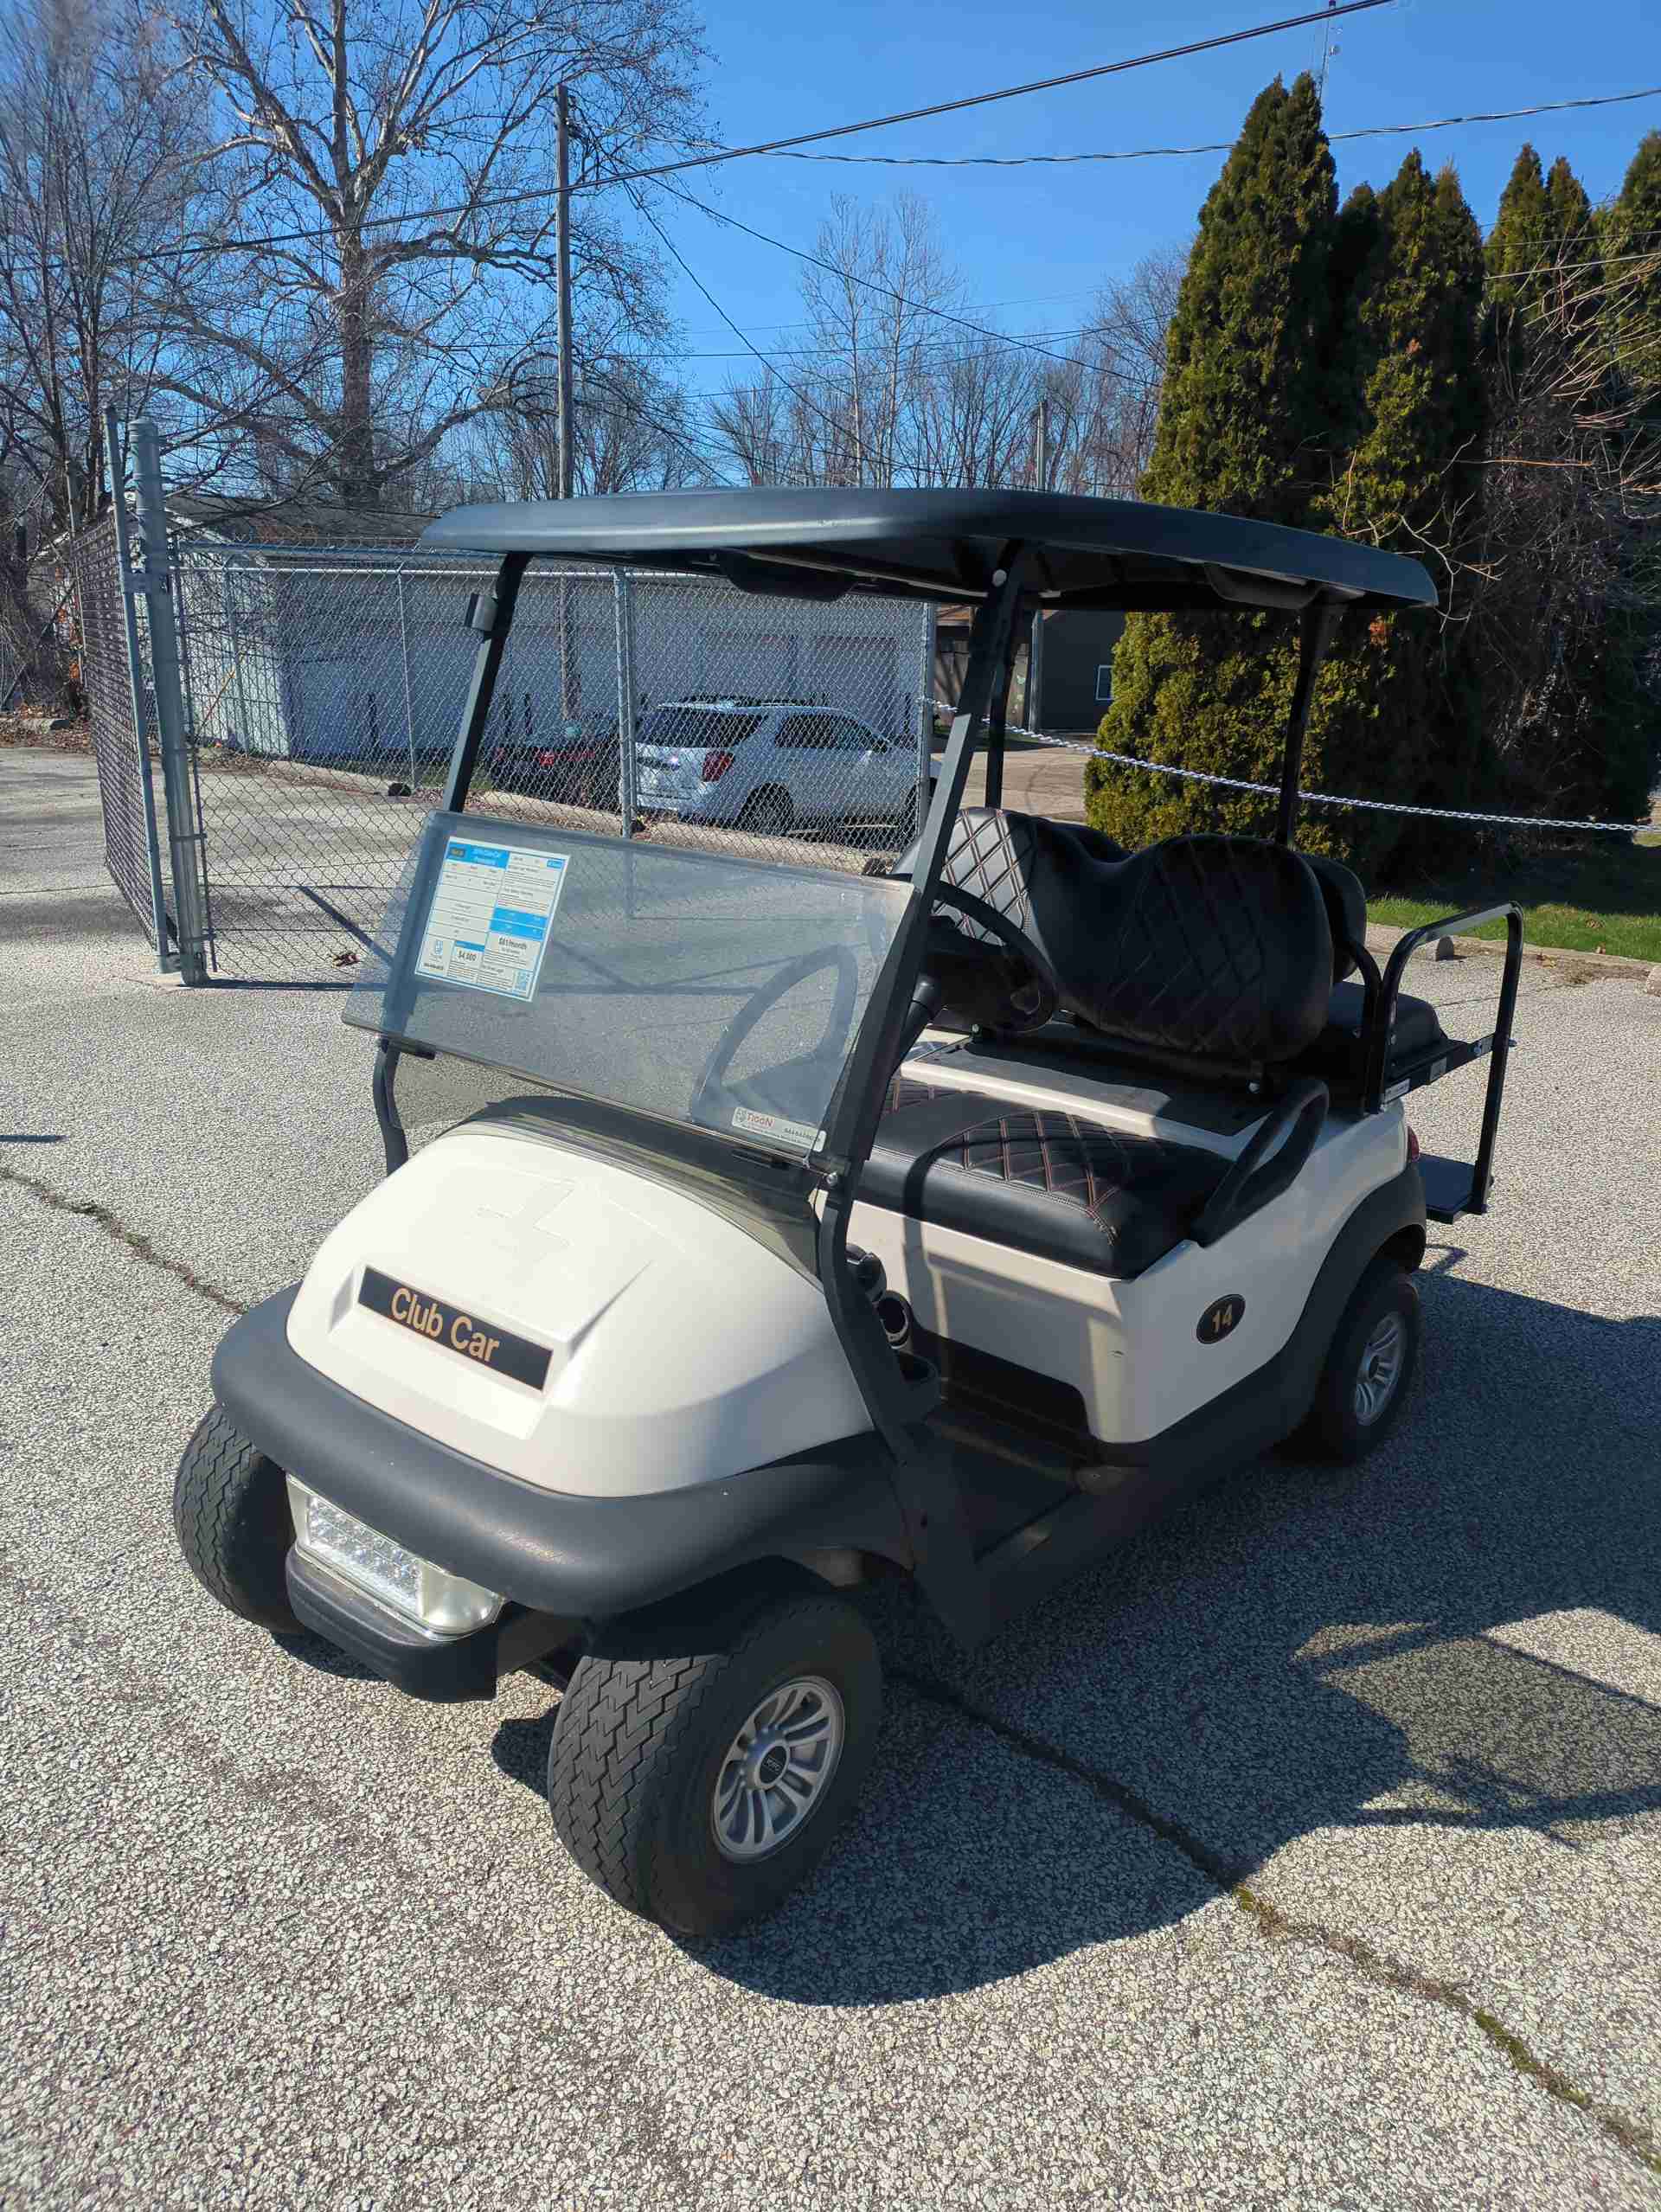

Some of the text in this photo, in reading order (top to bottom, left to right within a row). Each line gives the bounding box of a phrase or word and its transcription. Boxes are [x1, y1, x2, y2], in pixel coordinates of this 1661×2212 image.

[391, 1287, 499, 1362] Club Car
[1212, 1304, 1234, 1332] 14
